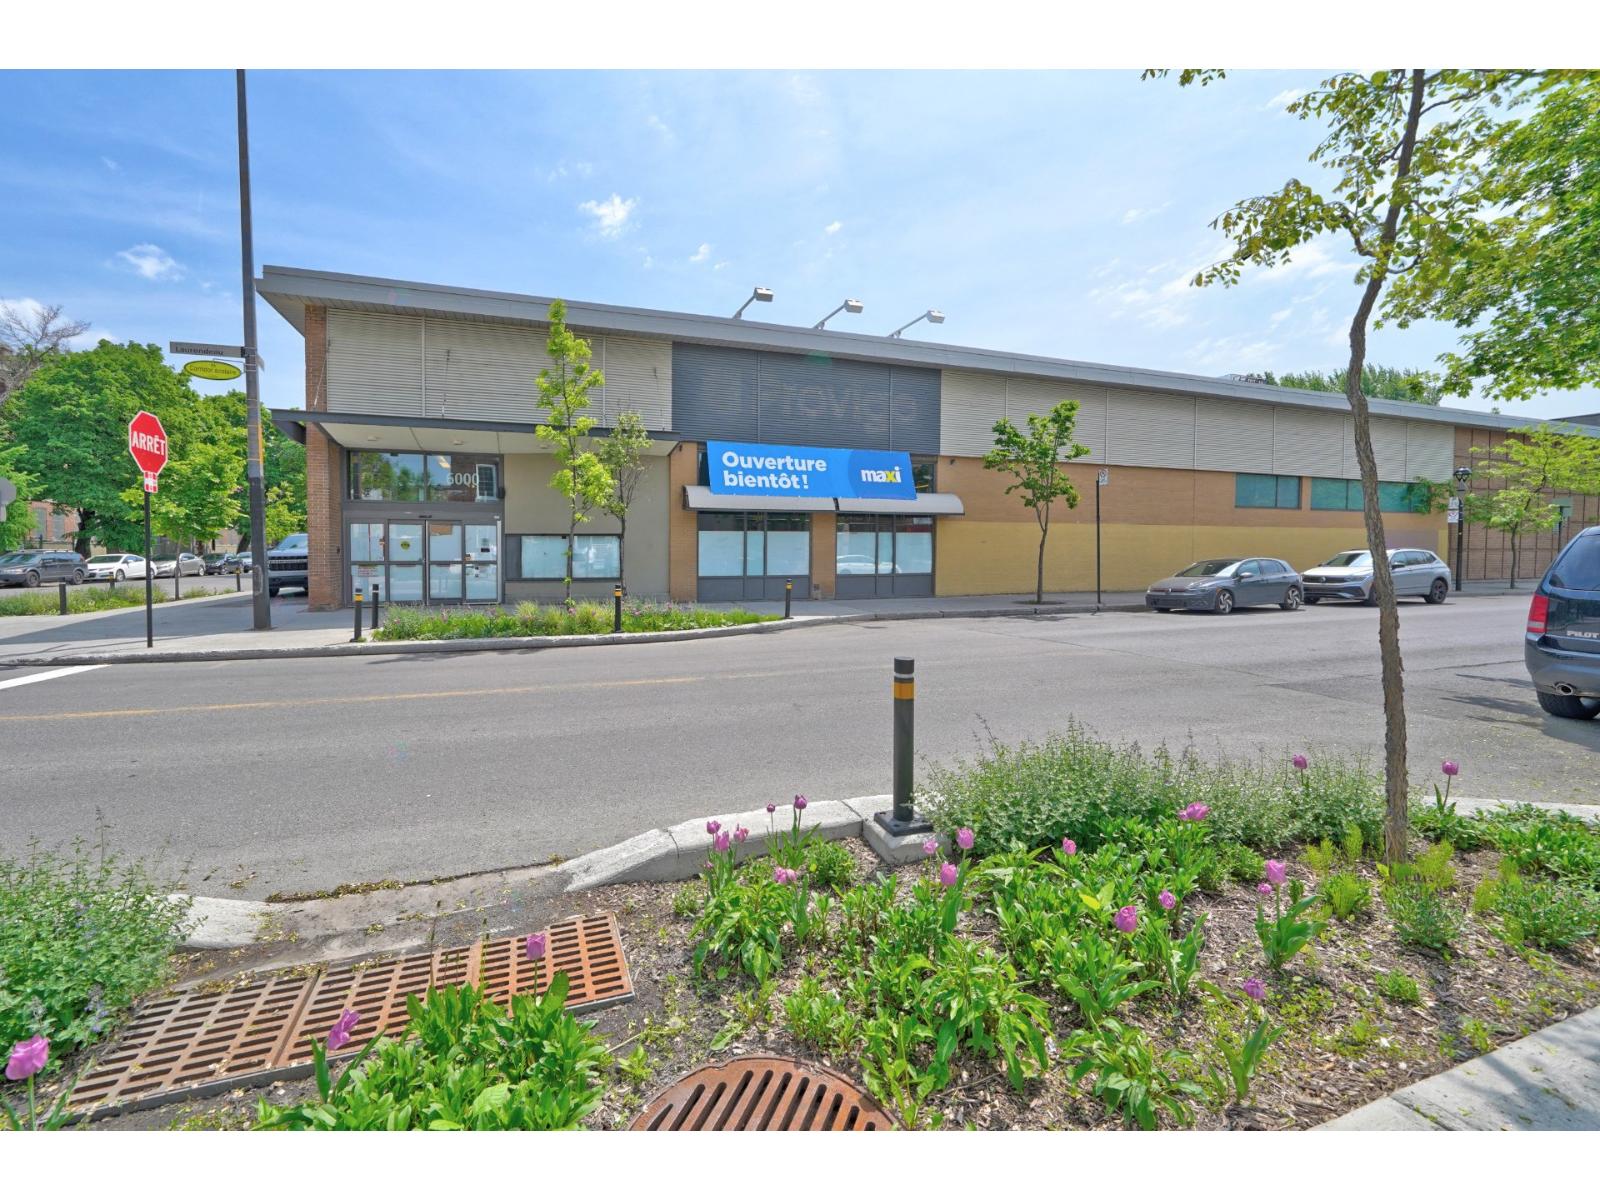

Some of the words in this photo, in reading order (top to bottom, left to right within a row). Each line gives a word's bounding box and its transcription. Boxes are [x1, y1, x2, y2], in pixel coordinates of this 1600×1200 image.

[175, 345, 224, 356] Laurendeau
[131, 431, 166, 456] ARRÊT
[722, 451, 827, 472] Ouverture
[861, 466, 902, 483] maxi
[1567, 630, 1600, 638] PILOT
